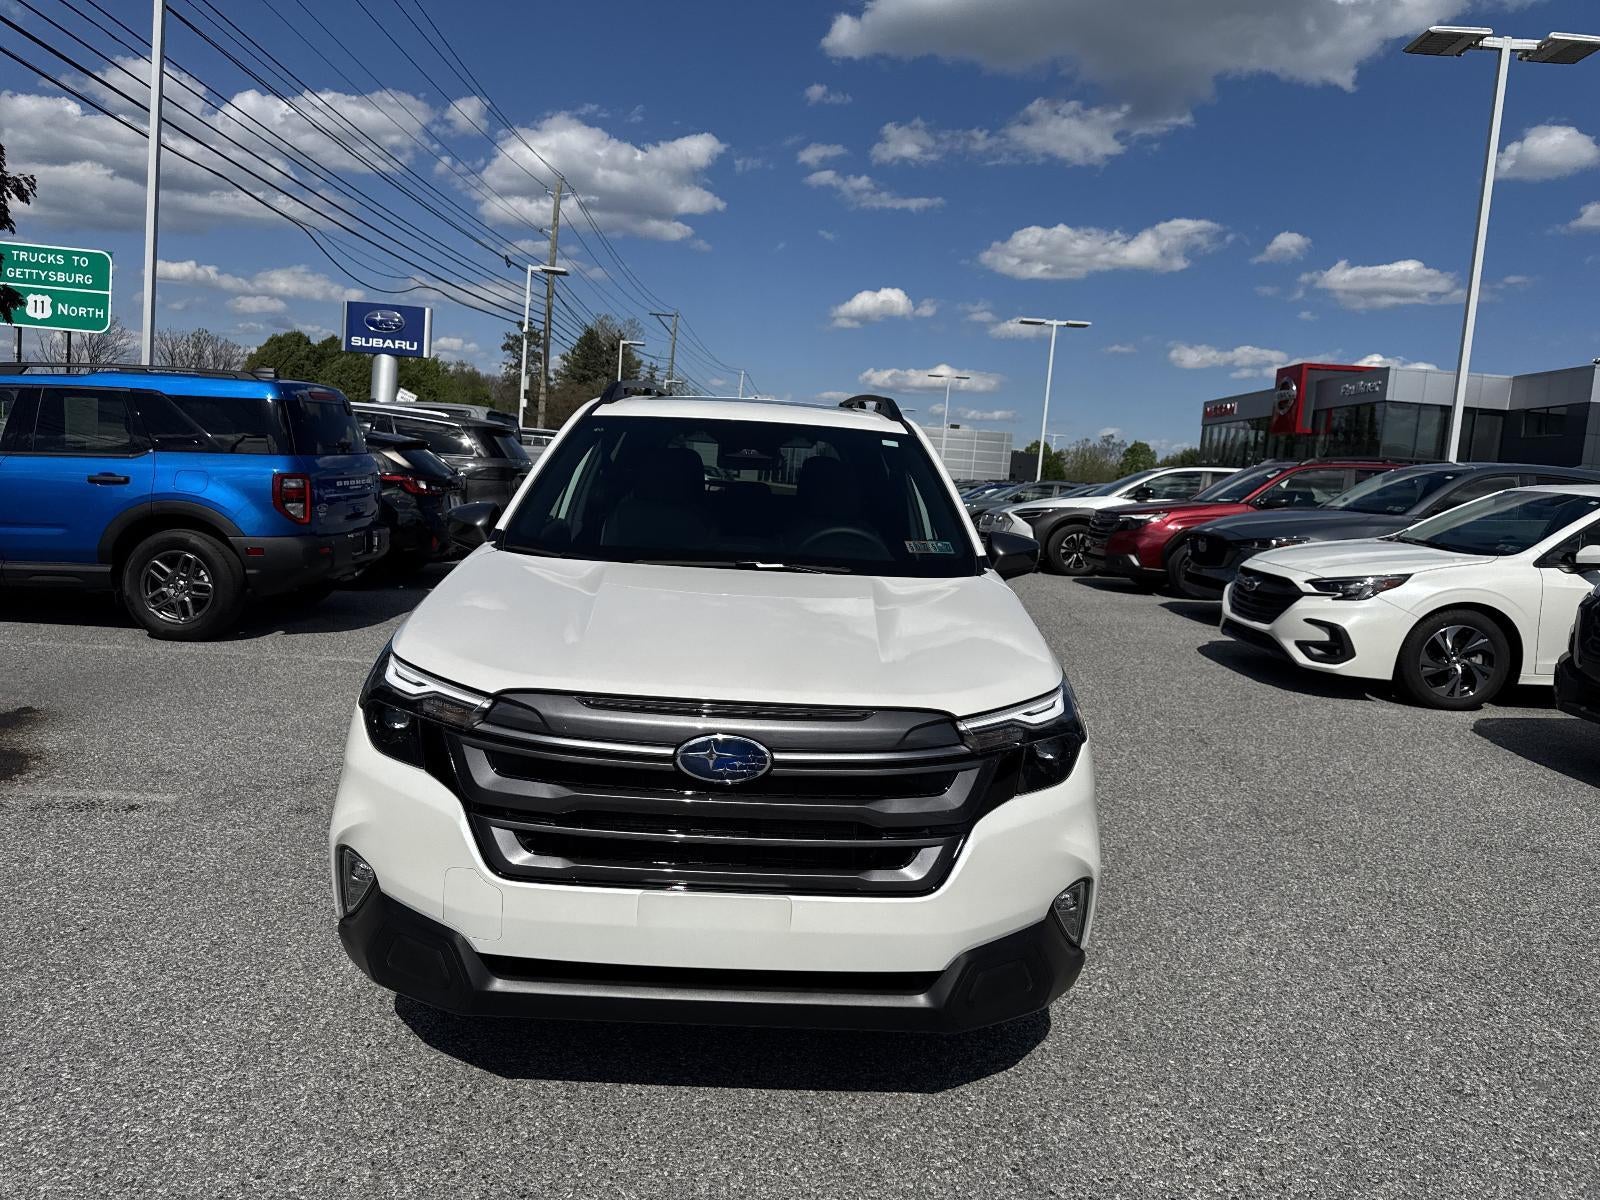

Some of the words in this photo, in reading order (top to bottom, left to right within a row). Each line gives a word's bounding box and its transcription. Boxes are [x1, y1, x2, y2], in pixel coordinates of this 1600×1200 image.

[11, 250, 65, 265] TRUCKS
[71, 256, 89, 267] TO
[6, 267, 93, 285] GETTYSBURG
[33, 299, 45, 314] 11
[350, 336, 418, 351] SUBARU
